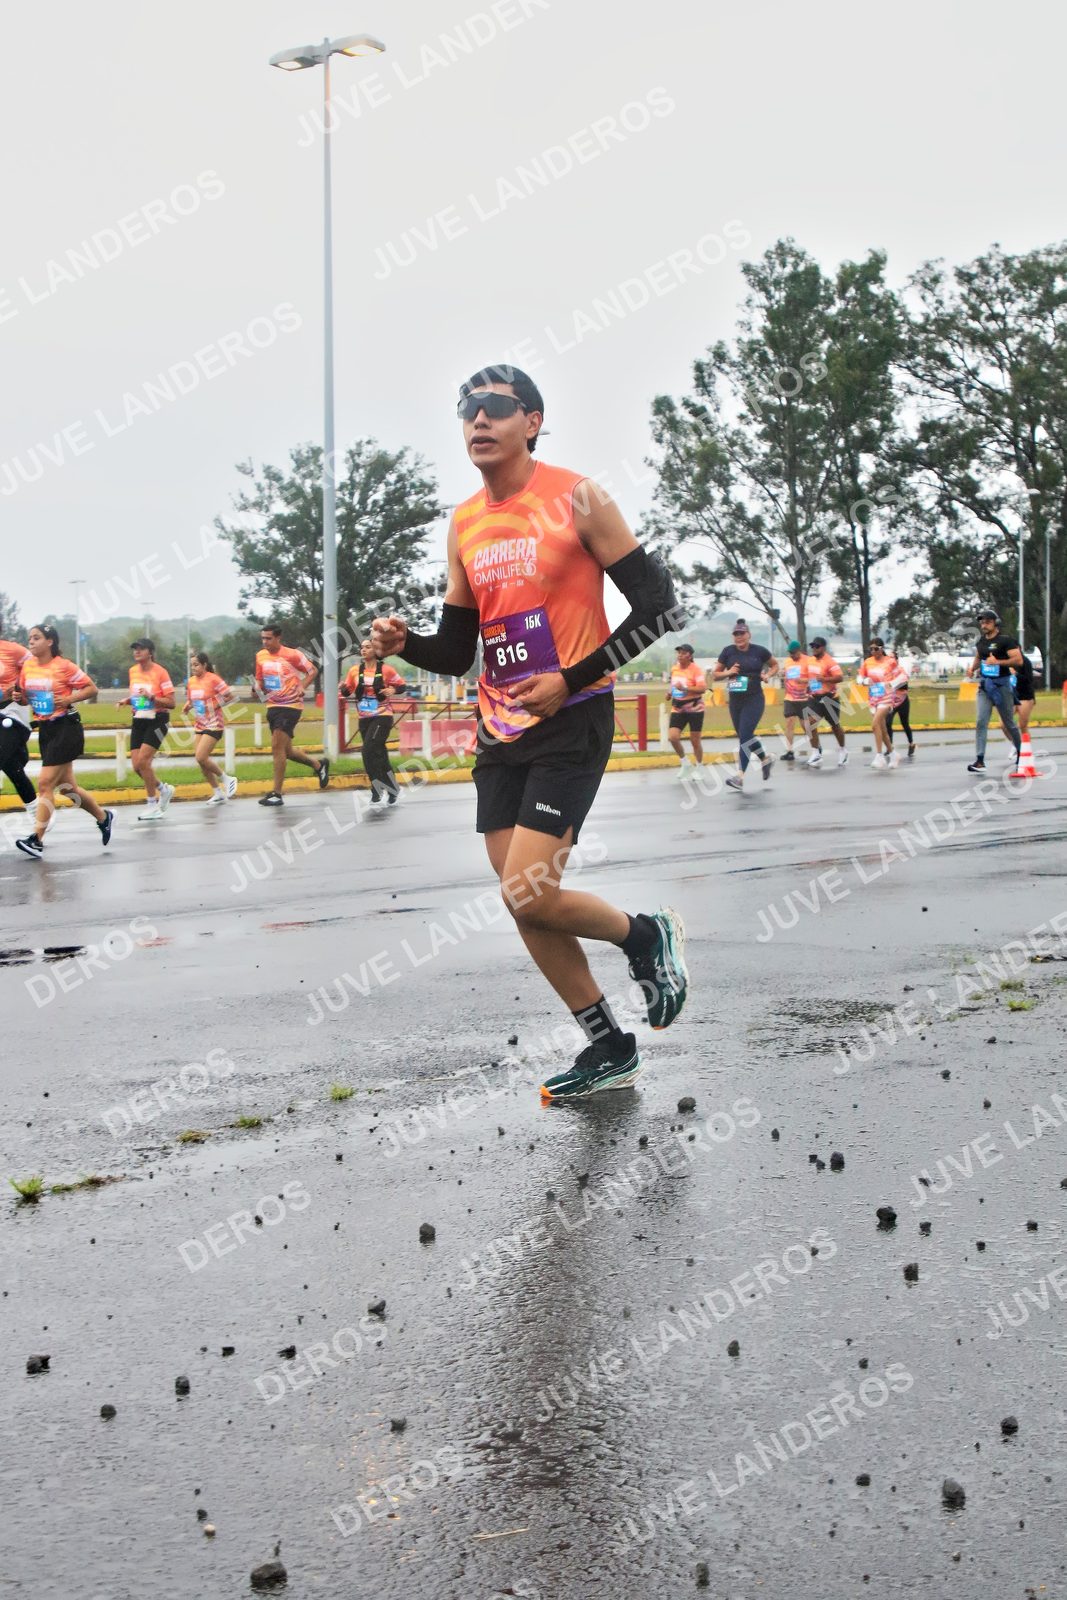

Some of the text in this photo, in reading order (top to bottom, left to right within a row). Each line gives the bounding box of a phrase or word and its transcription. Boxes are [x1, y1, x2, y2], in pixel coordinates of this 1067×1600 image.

[473, 537, 537, 570] CARRERA
[474, 563, 521, 586] OMNILIFE
[496, 642, 528, 666] 816
[536, 802, 561, 816] Wilson
